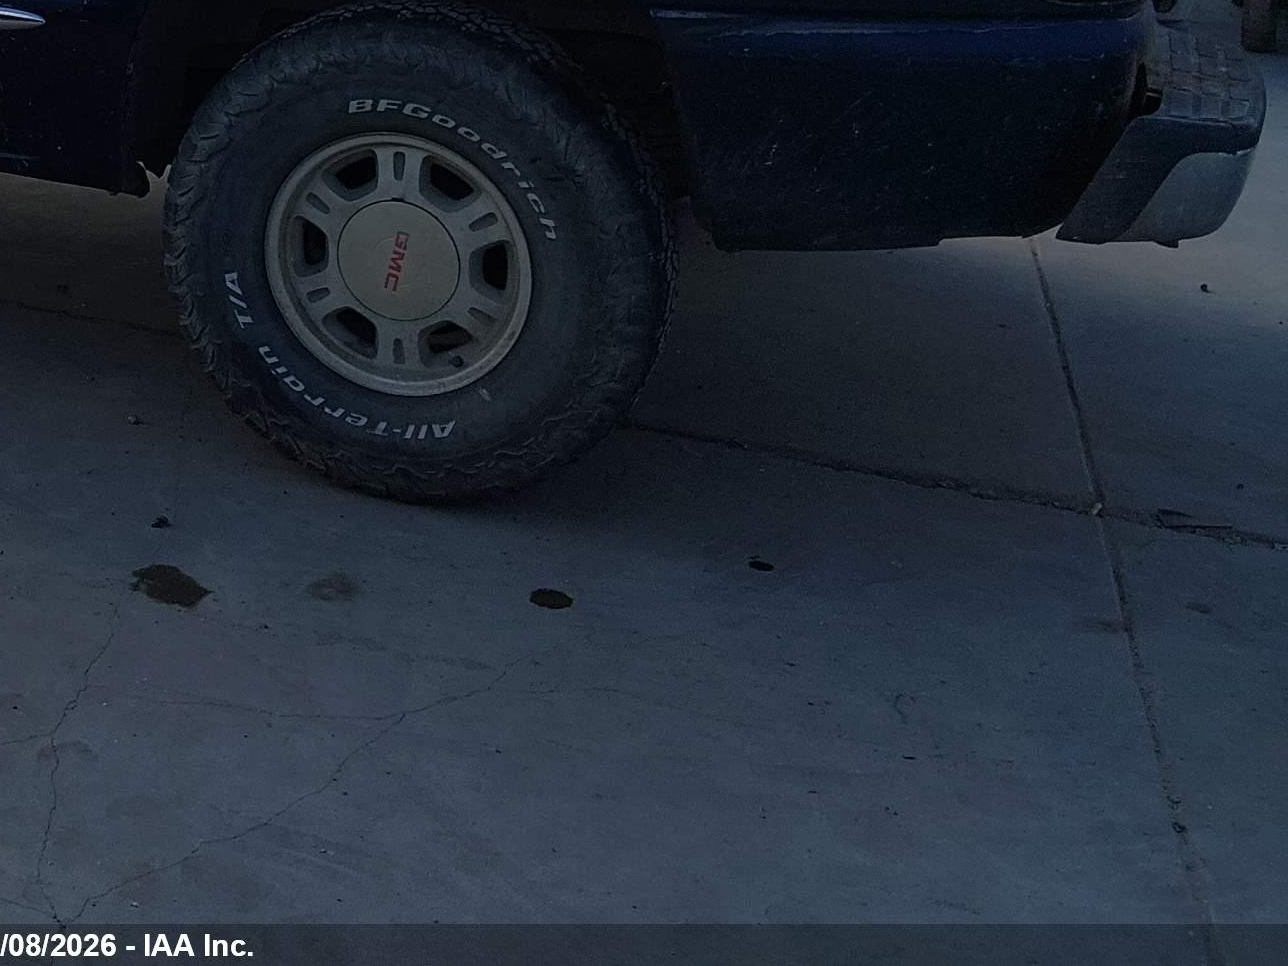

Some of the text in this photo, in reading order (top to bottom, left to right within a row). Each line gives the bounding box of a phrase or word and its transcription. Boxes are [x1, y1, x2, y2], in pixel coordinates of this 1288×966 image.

[347, 98, 558, 241] BFGoodrich
[383, 230, 410, 292] GMC
[223, 270, 457, 440] All-Terrain T/A
